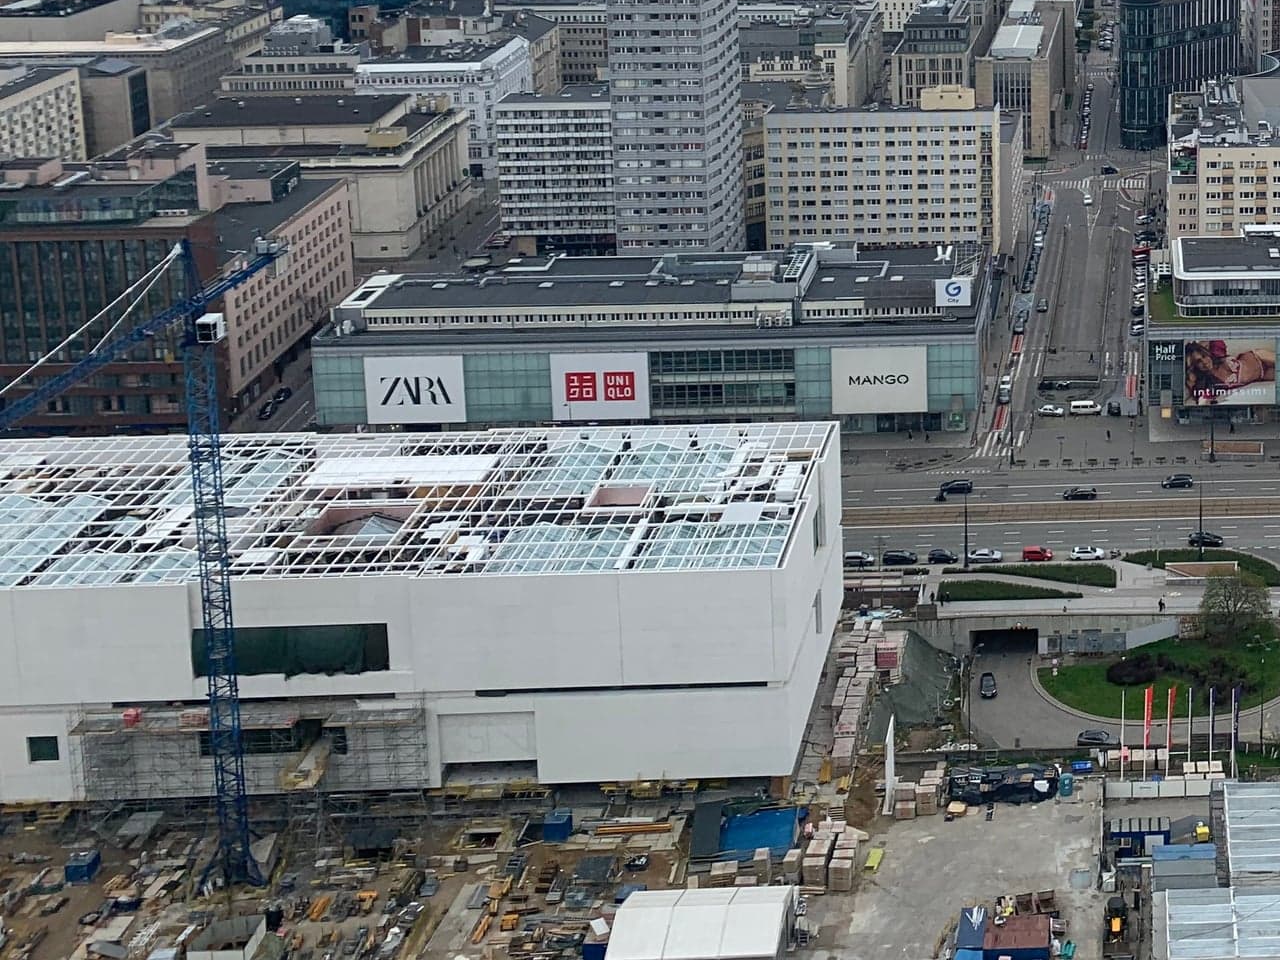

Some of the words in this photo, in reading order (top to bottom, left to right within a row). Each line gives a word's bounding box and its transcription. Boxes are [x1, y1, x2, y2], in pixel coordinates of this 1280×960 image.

[1155, 344, 1176, 354] Half
[1155, 353, 1177, 361] Price
[848, 374, 909, 386] MANGO
[380, 376, 454, 406] ZARA
